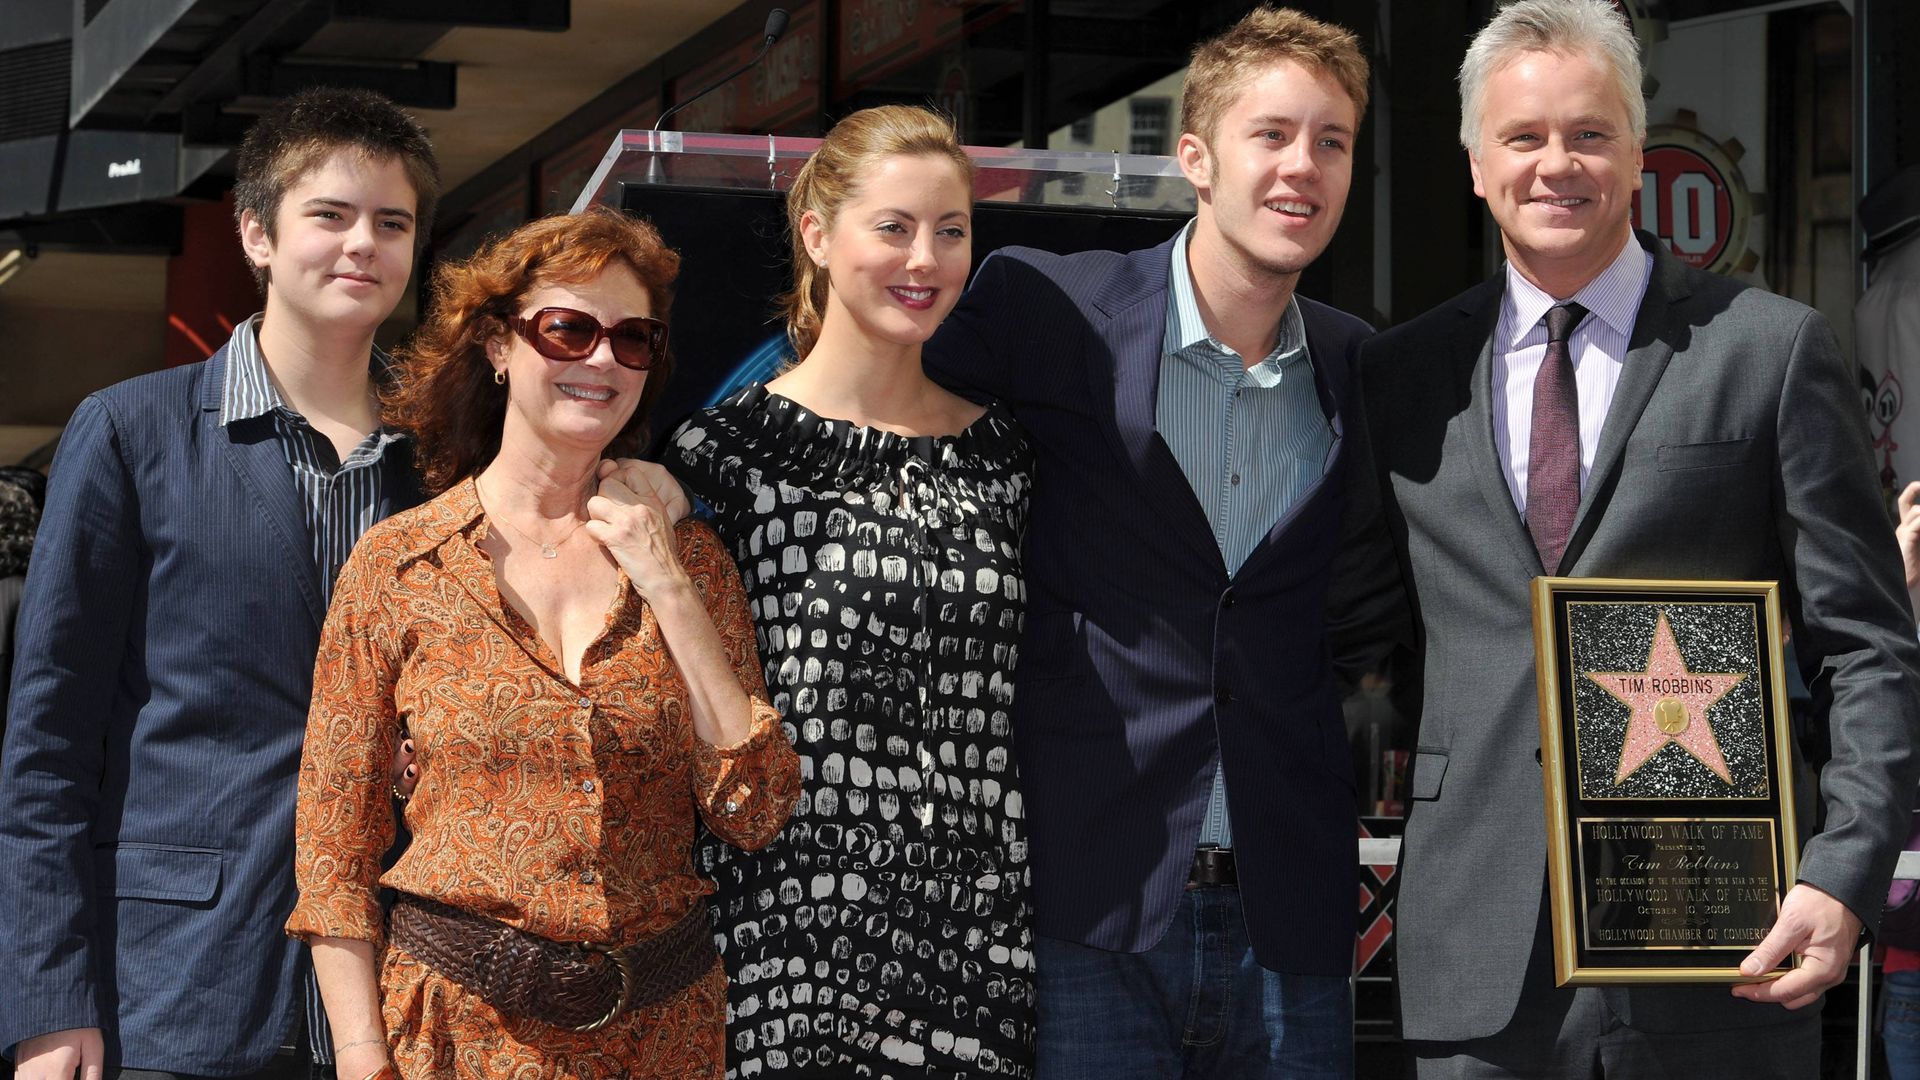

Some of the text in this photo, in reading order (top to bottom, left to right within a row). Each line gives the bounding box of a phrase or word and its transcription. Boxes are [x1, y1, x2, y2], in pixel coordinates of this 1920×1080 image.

[1619, 678, 1713, 694] TIM ROBBINS
[1592, 825, 1764, 840] HOLLYWOOD WALK OF FAME
[1622, 854, 1740, 871] Tim Robbins
[1620, 877, 1645, 886] OCCASION
[1672, 877, 1701, 886] PLACEMENT
[1714, 877, 1729, 886] YOUR
[1732, 877, 1746, 886] STAR
[1597, 888, 1769, 902] HOLLYWOOD WALK OF FAME
[1704, 904, 1731, 915] 2008
[1600, 928, 1655, 941] HOLLYWOOD
[1659, 928, 1701, 940] CHAMBER
[1707, 928, 1718, 940] OF
